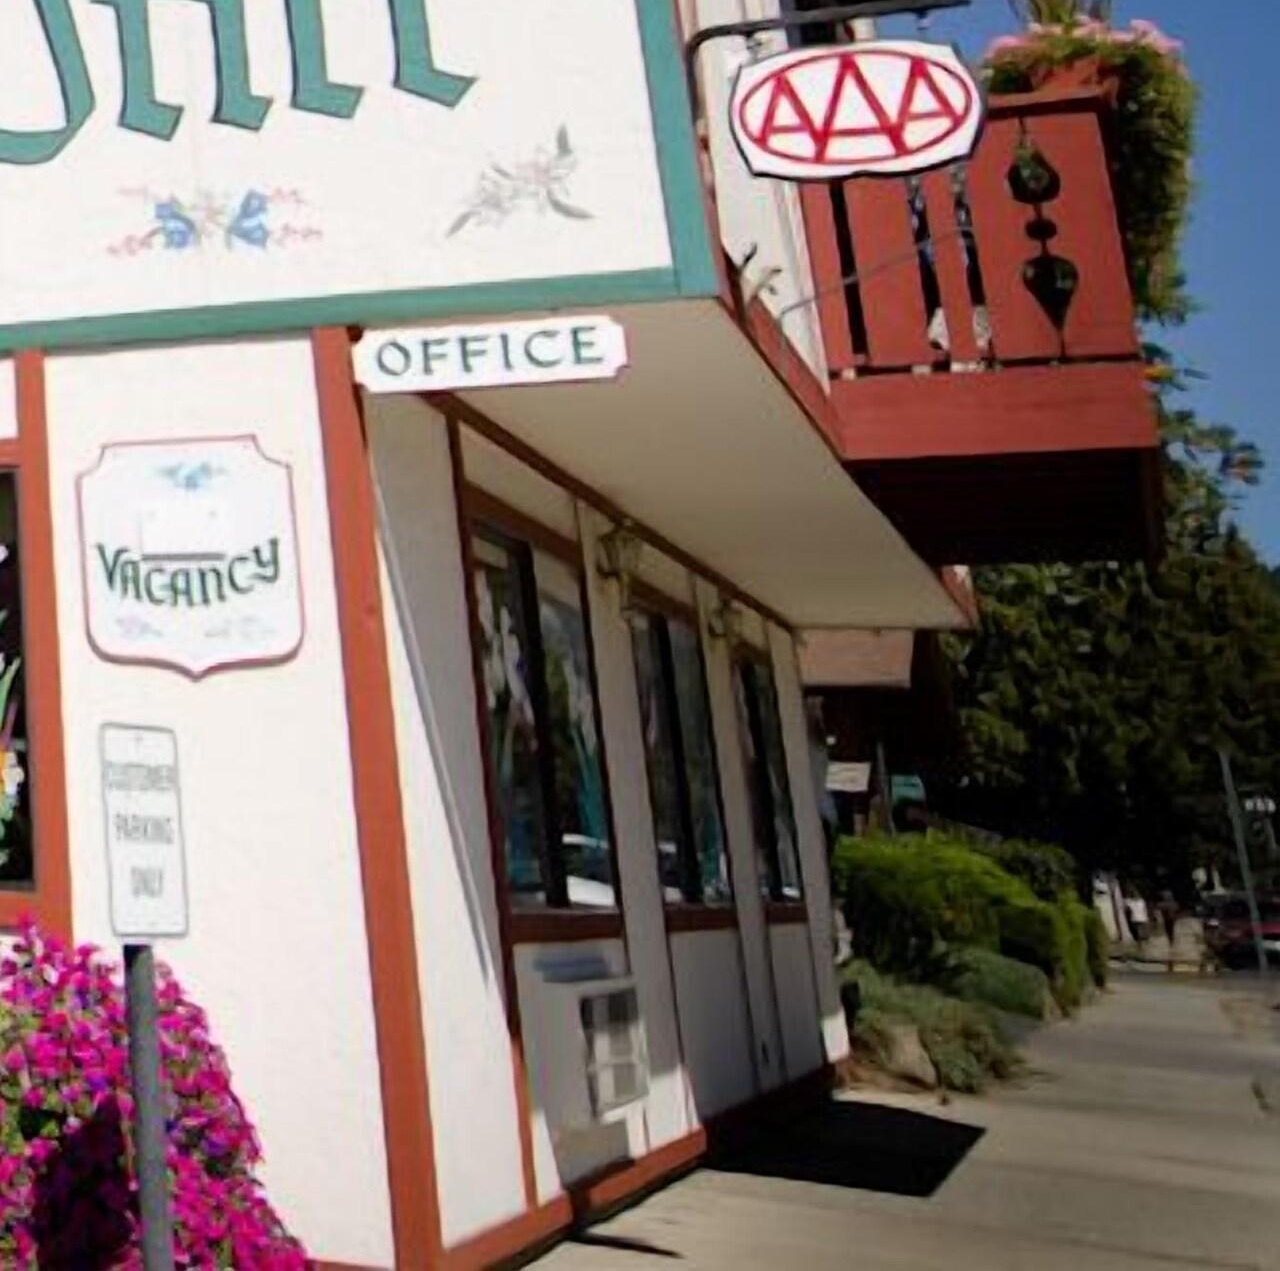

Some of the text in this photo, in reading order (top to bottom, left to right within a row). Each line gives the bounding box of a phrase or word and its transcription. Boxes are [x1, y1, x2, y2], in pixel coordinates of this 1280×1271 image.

[756, 51, 965, 162] AAA
[376, 326, 603, 376] OFFICE
[115, 812, 174, 845] PARKING
[131, 866, 163, 898] ONLY
